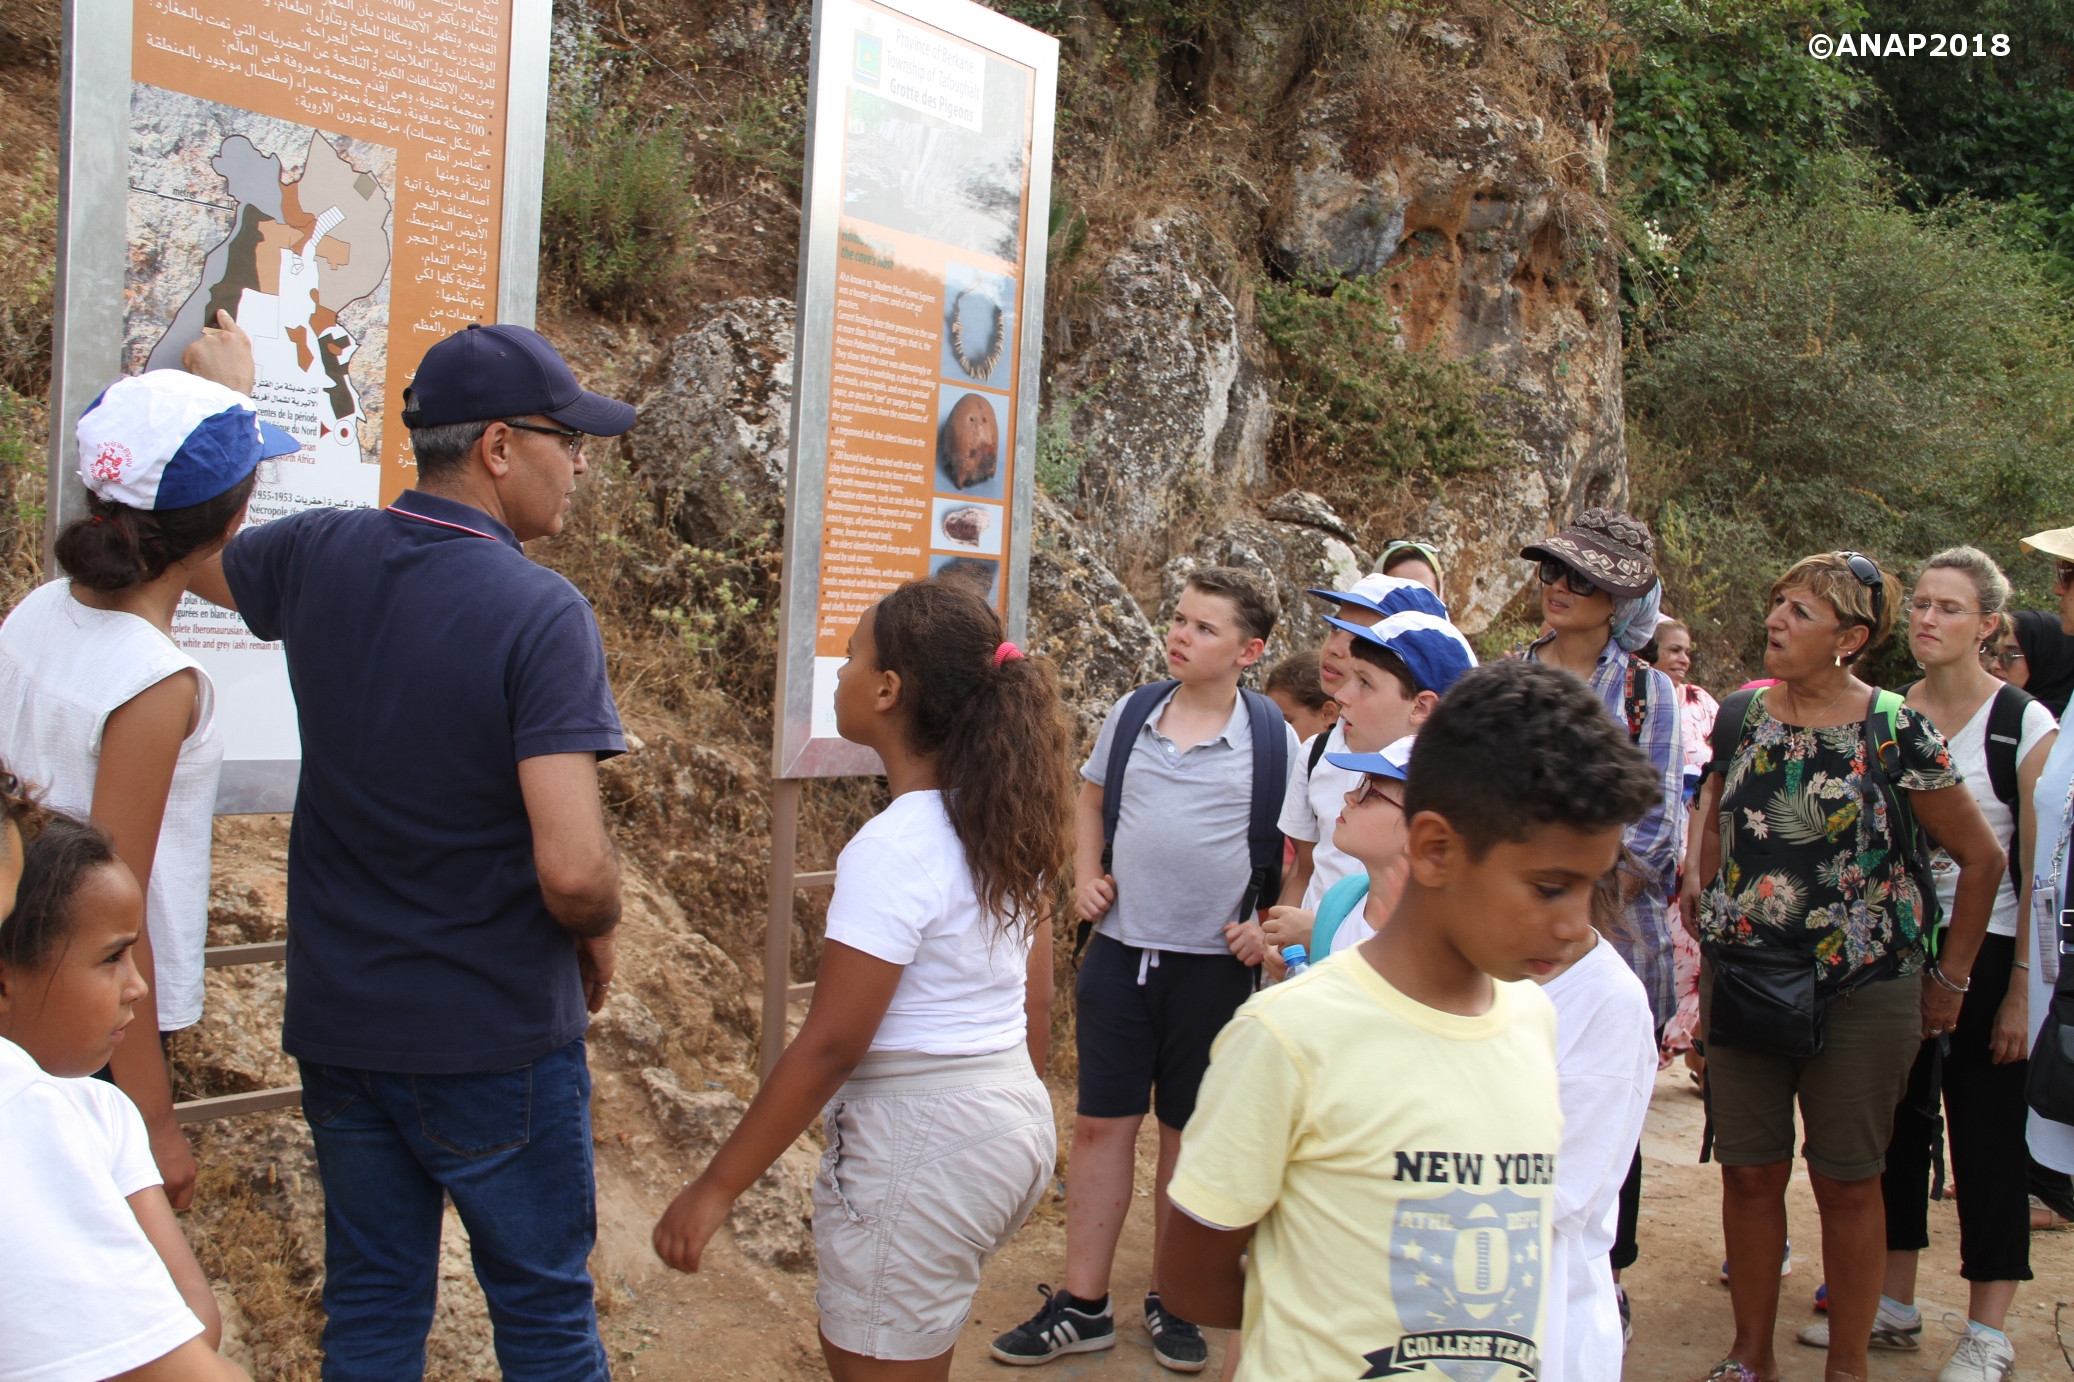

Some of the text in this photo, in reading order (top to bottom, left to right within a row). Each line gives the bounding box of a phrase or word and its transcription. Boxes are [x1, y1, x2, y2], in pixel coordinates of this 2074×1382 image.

[315, 8, 348, 30] وتناول
[418, 8, 432, 18] من
[206, 16, 230, 29] تمت
[232, 24, 256, 36] التي
[350, 20, 380, 36] للطبخ
[376, 11, 429, 34] الاكتشافات
[146, 32, 201, 62] بالمنطقة
[258, 30, 310, 52] الحفريات
[261, 51, 280, 63] في
[313, 48, 329, 59] عن
[332, 48, 369, 69] الناتجة
[442, 46, 467, 66] ورشة
[896, 28, 973, 74] Province of Berkane
[206, 54, 241, 72] موجود
[283, 53, 321, 74] معروفة
[372, 62, 404, 79] الكبيرة
[468, 57, 496, 73] الوقت
[886, 49, 924, 82] Township
[926, 68, 936, 82] of
[324, 65, 362, 88] جمجمة
[406, 74, 457, 94] الاكتشافات
[445, 68, 495, 90] للروحانيات
[296, 77, 328, 94] حمراء
[390, 90, 412, 103] وهي
[458, 89, 474, 103] بين
[476, 95, 494, 109] ومن
[890, 78, 973, 122] Grotte des Pigeons
[336, 108, 366, 126] بقرون
[452, 101, 485, 122] جمجمة
[370, 114, 400, 133] مرفقة
[444, 116, 460, 133] جثة
[464, 122, 484, 136] 200
[448, 136, 471, 150] شكل
[473, 144, 491, 156] على
[452, 158, 483, 170] عناصر
[436, 166, 459, 185] ومنها
[424, 180, 452, 200] بحرية
[454, 190, 489, 205] أصداف
[412, 200, 488, 224] من ضفاف البحر
[455, 224, 488, 240] الأبيض
[406, 234, 487, 260] وأجزاء من الحجر
[452, 260, 474, 273] بيض
[477, 262, 486, 276] أو
[414, 268, 434, 283] لكي
[437, 270, 454, 284] كلها
[470, 296, 484, 309] يتم
[429, 306, 476, 321] معدات من
[278, 408, 286, 418] de
[287, 409, 293, 420] la
[294, 412, 318, 423] période
[291, 424, 300, 434] du
[301, 426, 316, 436] Nord
[250, 505, 288, 516] Nécropole
[184, 596, 198, 607] plus
[210, 609, 228, 618] blanc
[182, 637, 200, 648] white
[202, 638, 214, 648] and
[216, 641, 230, 652] grey
[249, 641, 271, 650] remain
[1393, 1151, 1484, 1185] NEW
[1402, 1335, 1492, 1358] COLLEGE
